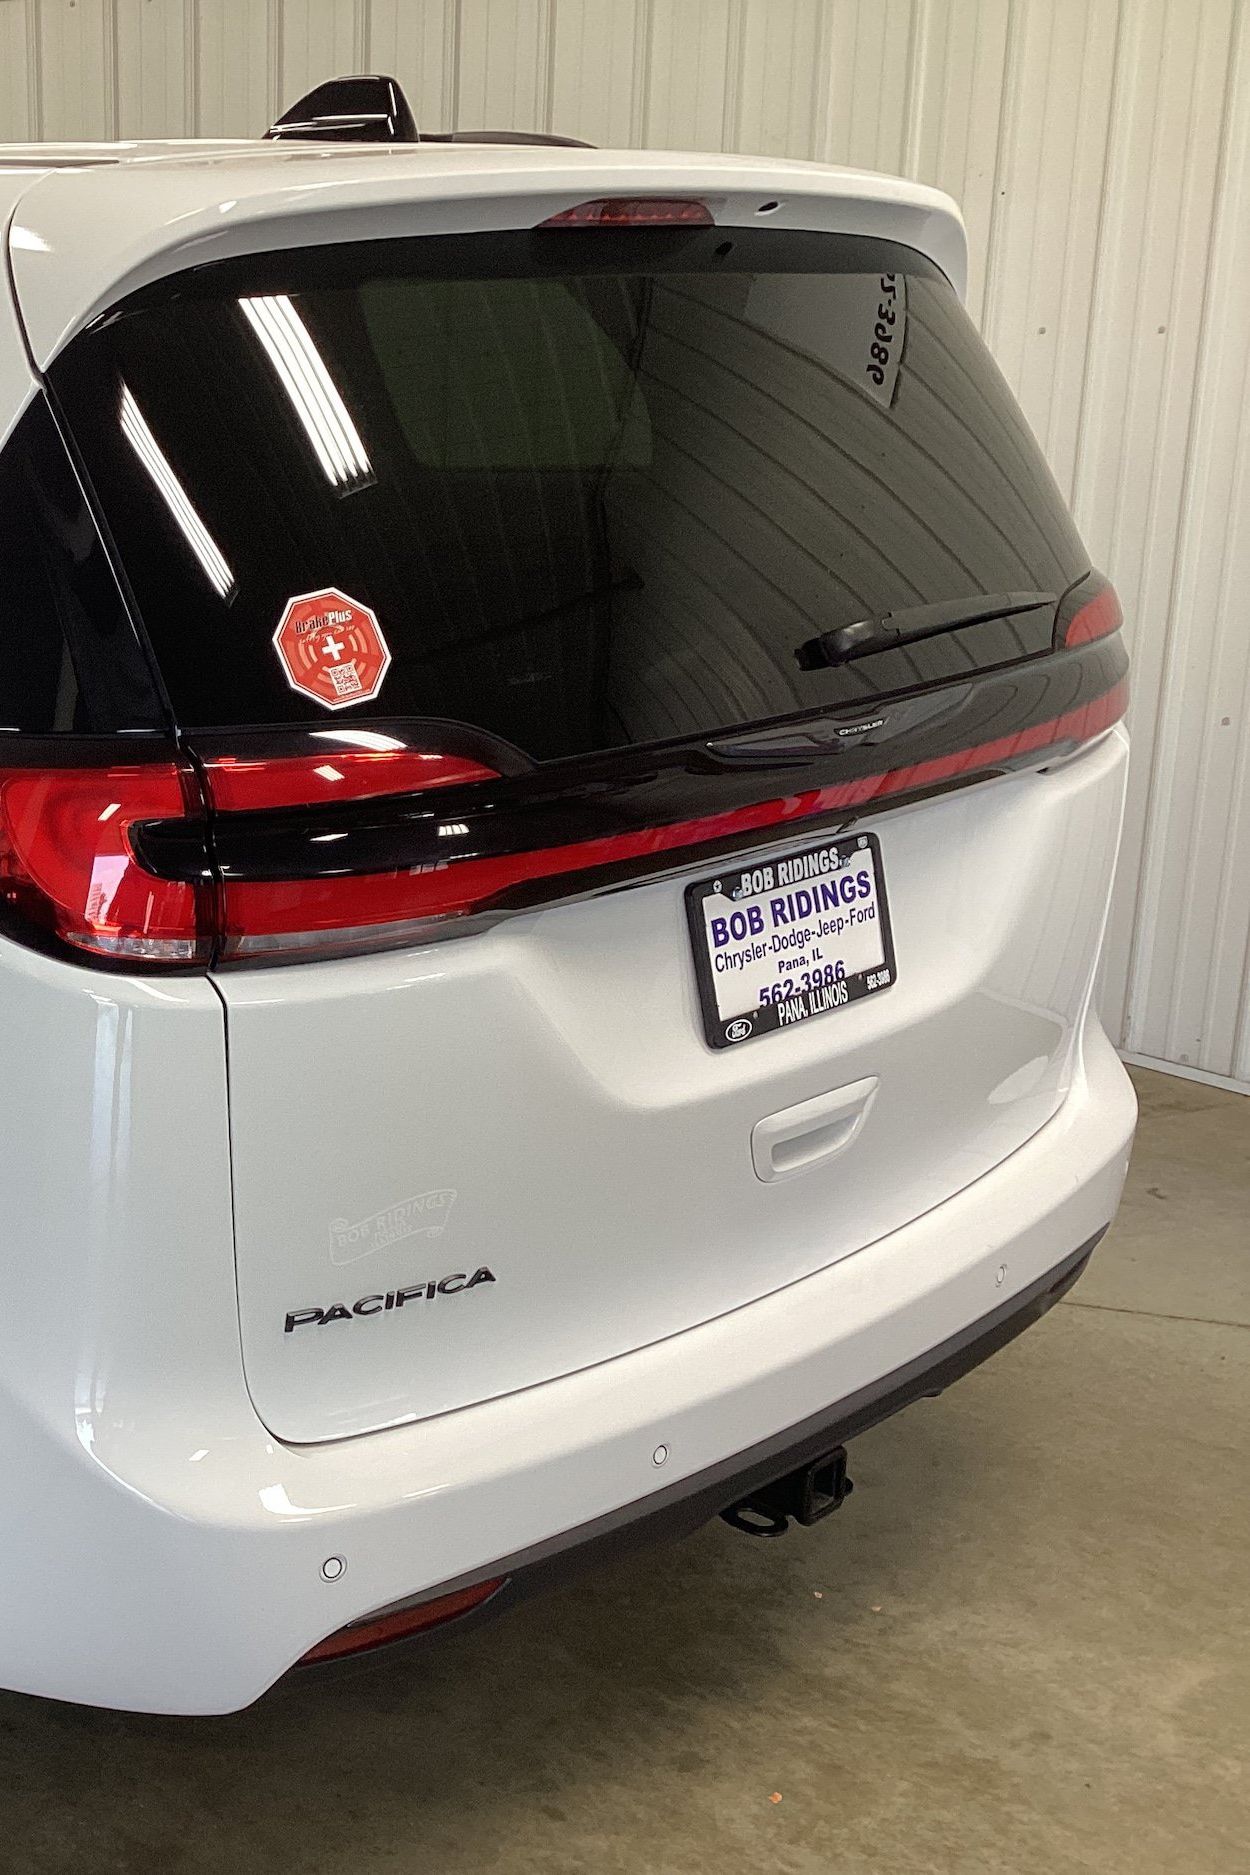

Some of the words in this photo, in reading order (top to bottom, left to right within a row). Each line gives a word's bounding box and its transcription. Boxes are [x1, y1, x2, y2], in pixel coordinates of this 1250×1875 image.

[741, 868, 775, 895] BOB
[777, 847, 839, 886] RIDINGS
[710, 904, 765, 948] BOB
[770, 870, 872, 928] RIDINGS
[715, 902, 876, 973] Chrysler-Dodge-Jeep-Ford
[778, 955, 810, 974] Pana,
[812, 948, 824, 962] IL
[758, 959, 846, 1007] 562-3986
[808, 981, 849, 1017] ILLINOIS
[376, 1193, 447, 1230] RIDINGS
[284, 1266, 497, 1333] PACIFICA
